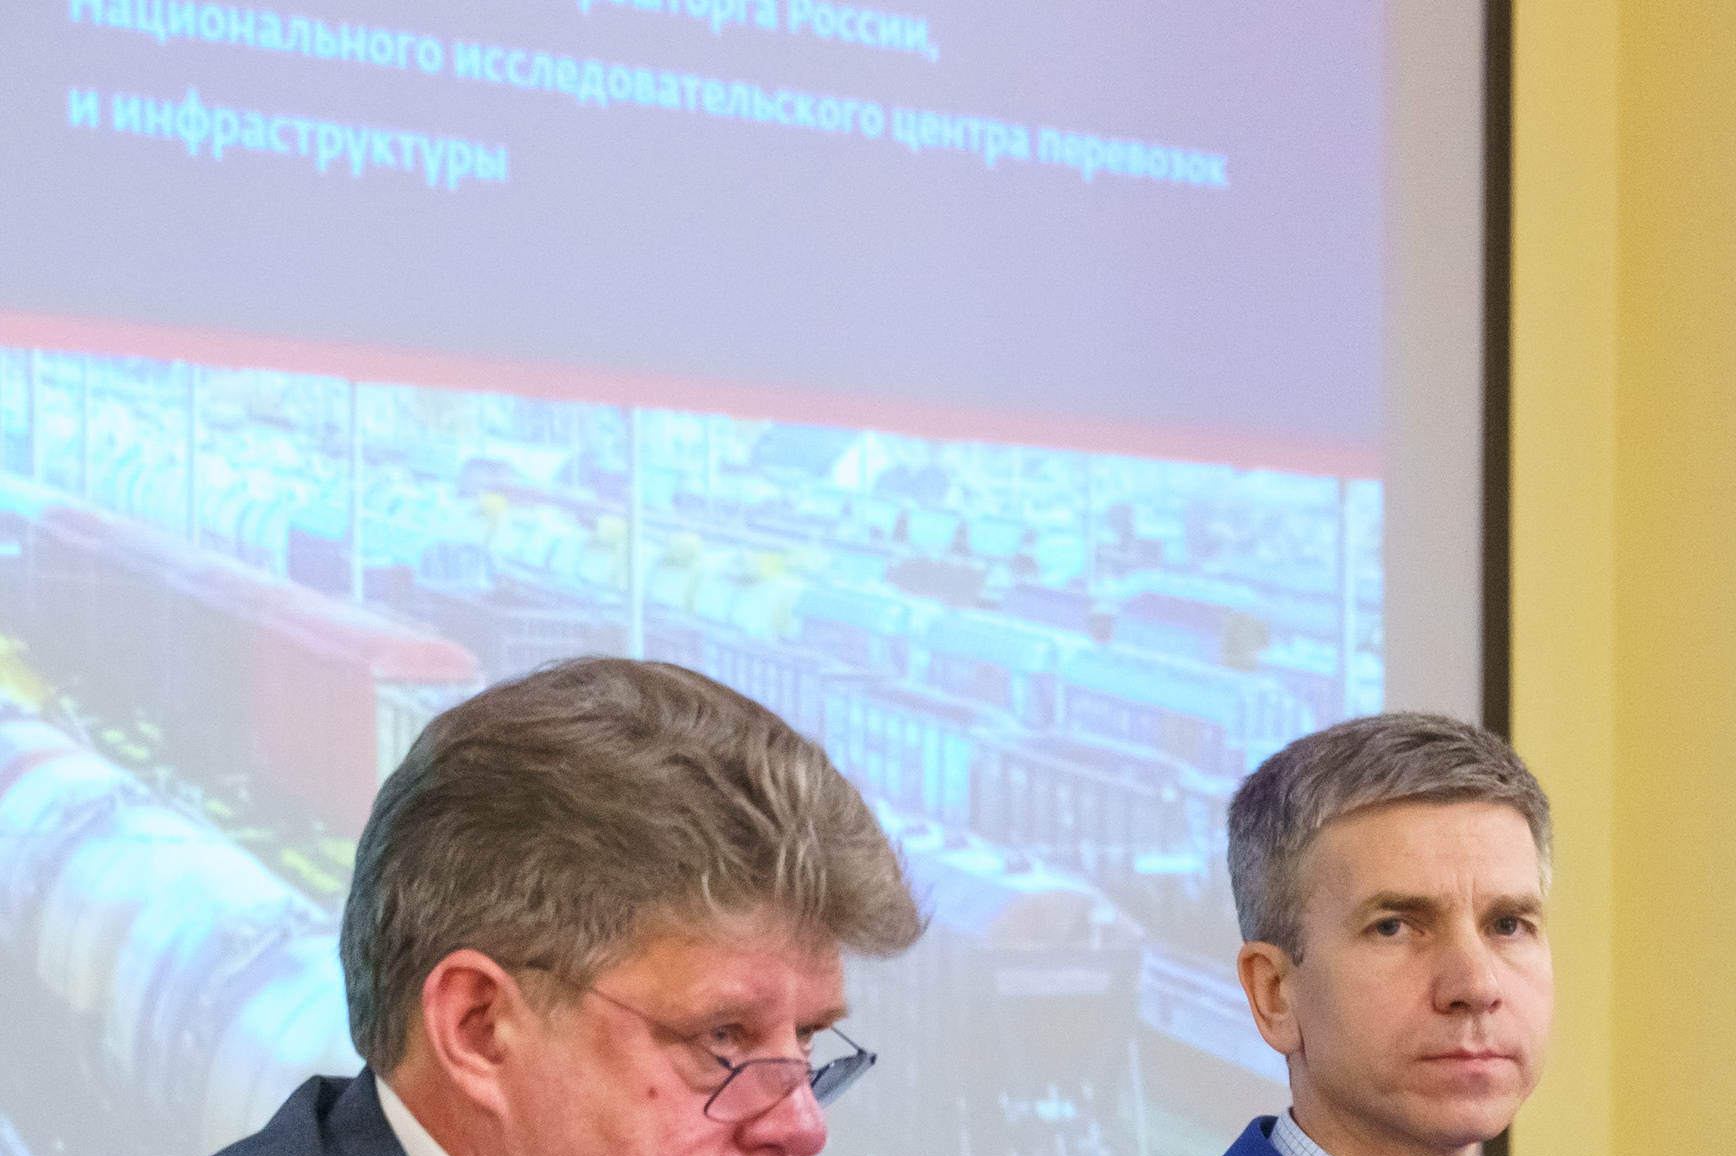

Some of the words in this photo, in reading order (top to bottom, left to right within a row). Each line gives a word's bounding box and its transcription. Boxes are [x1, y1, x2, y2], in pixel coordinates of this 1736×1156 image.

[67, 88, 100, 127] и
[112, 86, 508, 190] инфраструктуры
[454, 41, 885, 138] исследовательского
[892, 106, 1029, 168] центра
[1037, 126, 1229, 189] перевозок
